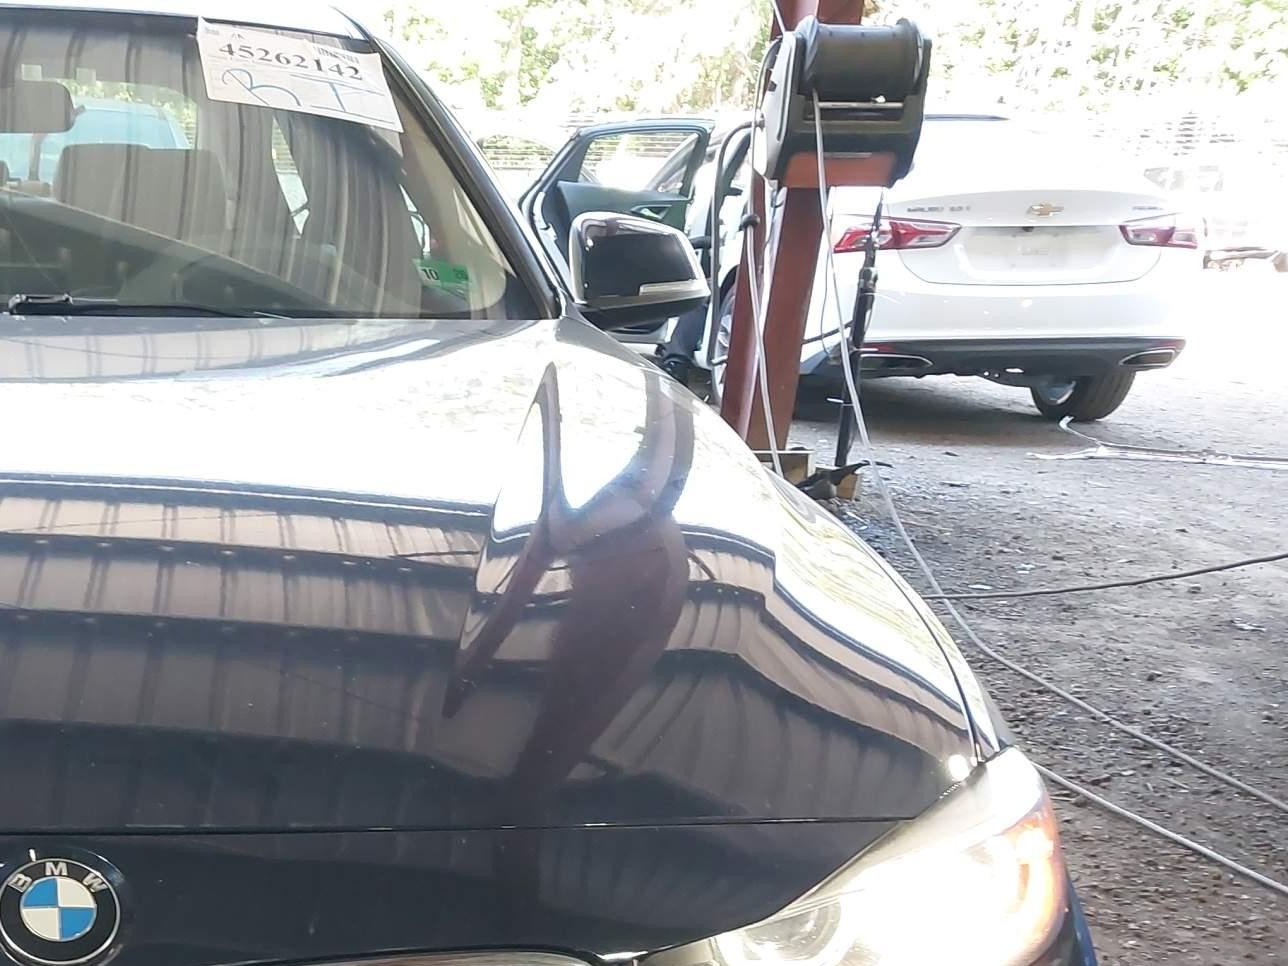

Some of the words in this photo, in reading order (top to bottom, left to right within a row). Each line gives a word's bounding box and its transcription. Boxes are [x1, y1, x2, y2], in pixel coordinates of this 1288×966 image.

[218, 43, 363, 81] 45262142
[421, 267, 440, 281] 10
[8, 861, 108, 893] BMW
